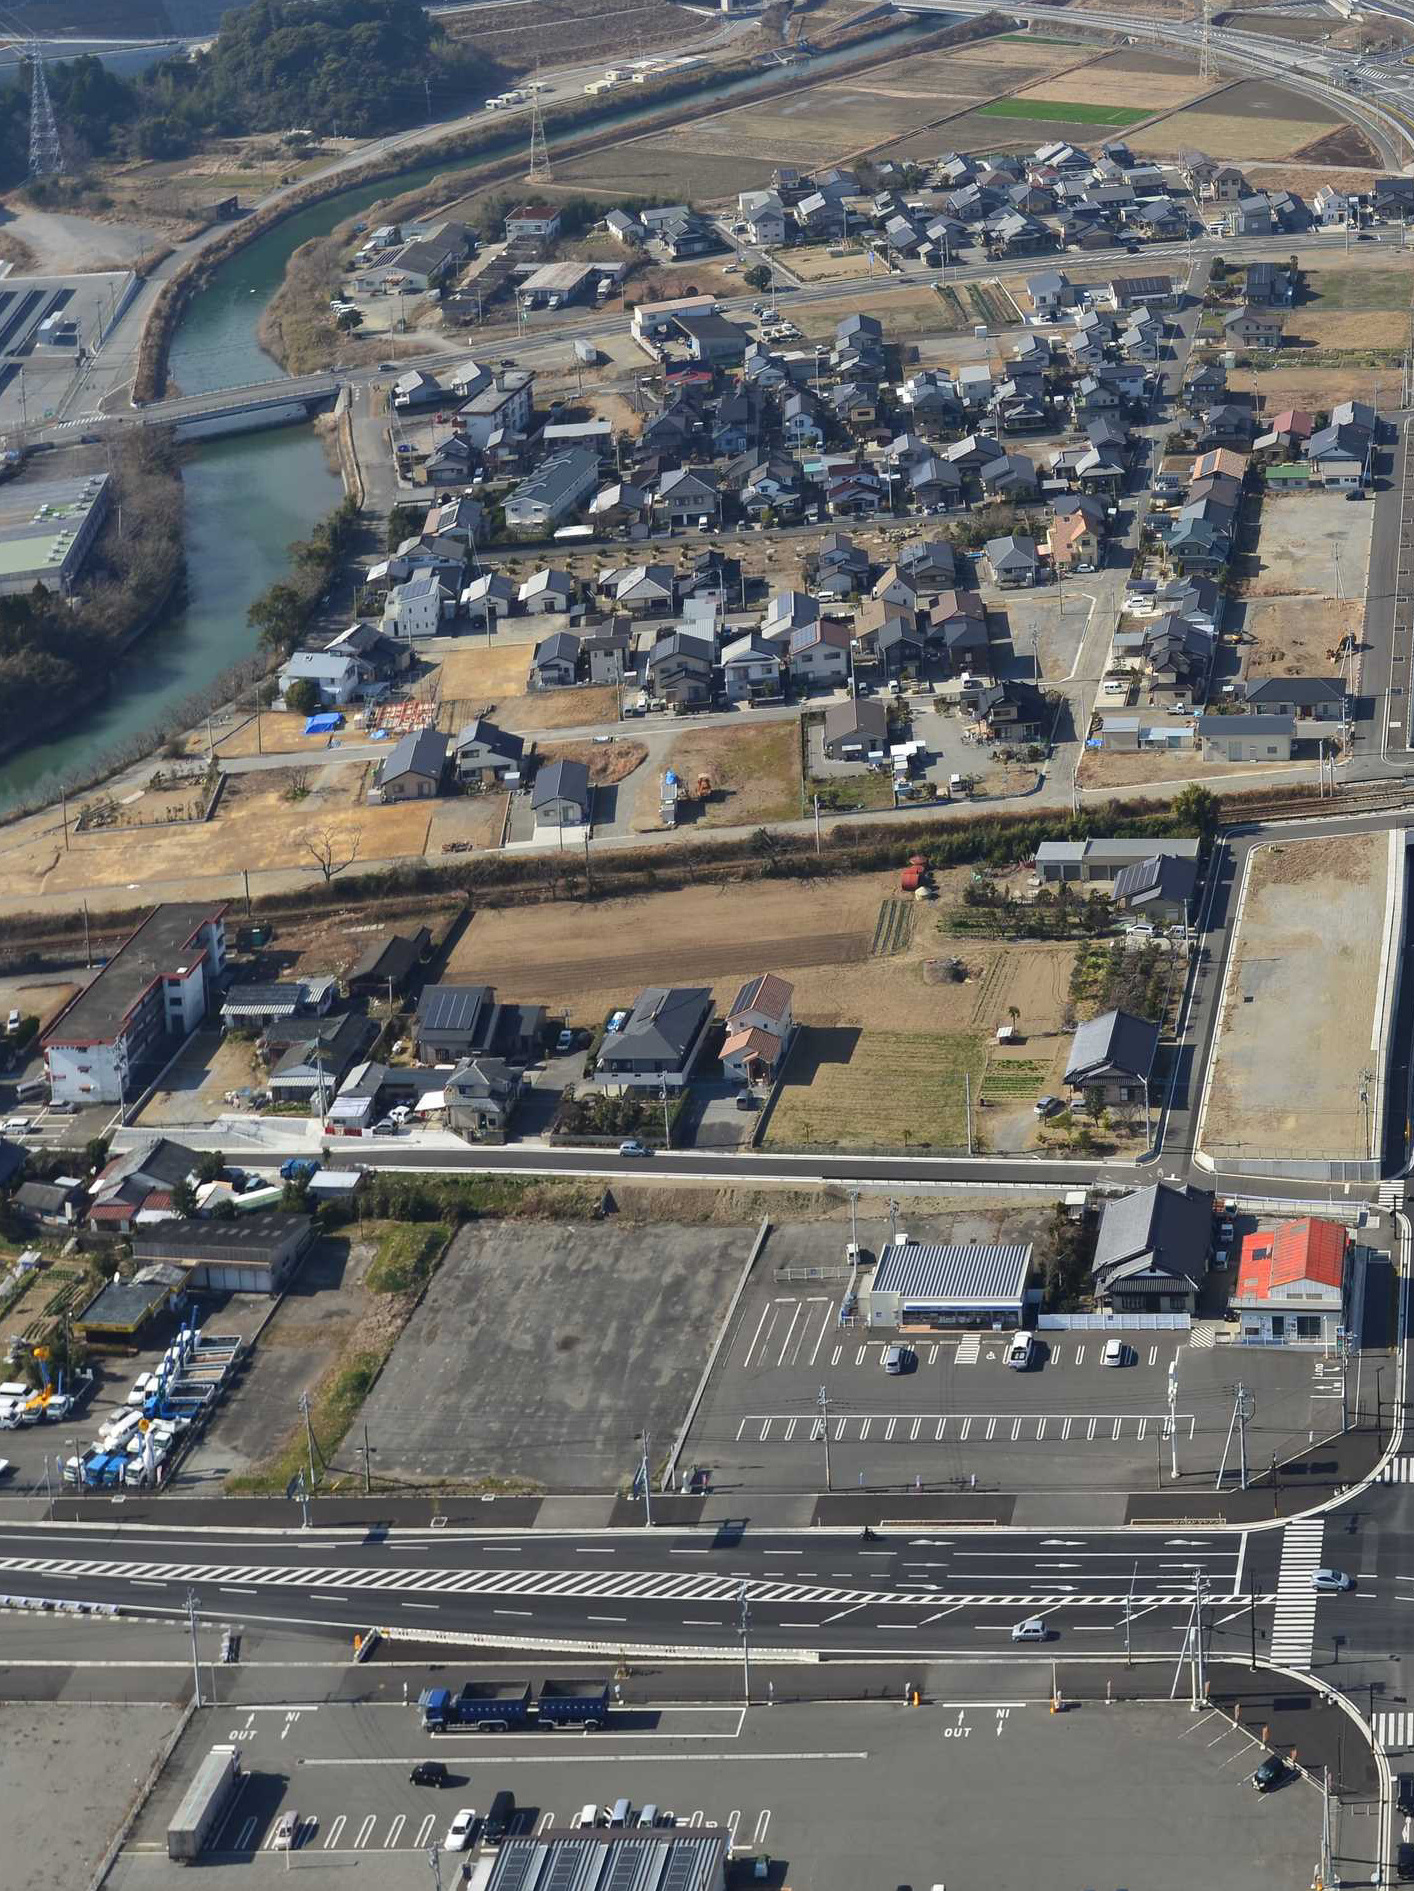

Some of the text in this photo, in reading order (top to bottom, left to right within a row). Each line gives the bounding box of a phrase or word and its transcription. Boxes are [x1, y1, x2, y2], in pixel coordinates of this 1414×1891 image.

[1314, 1363, 1324, 1377] OUT
[229, 1730, 258, 1740] OUT
[944, 1727, 972, 1738] OUT
